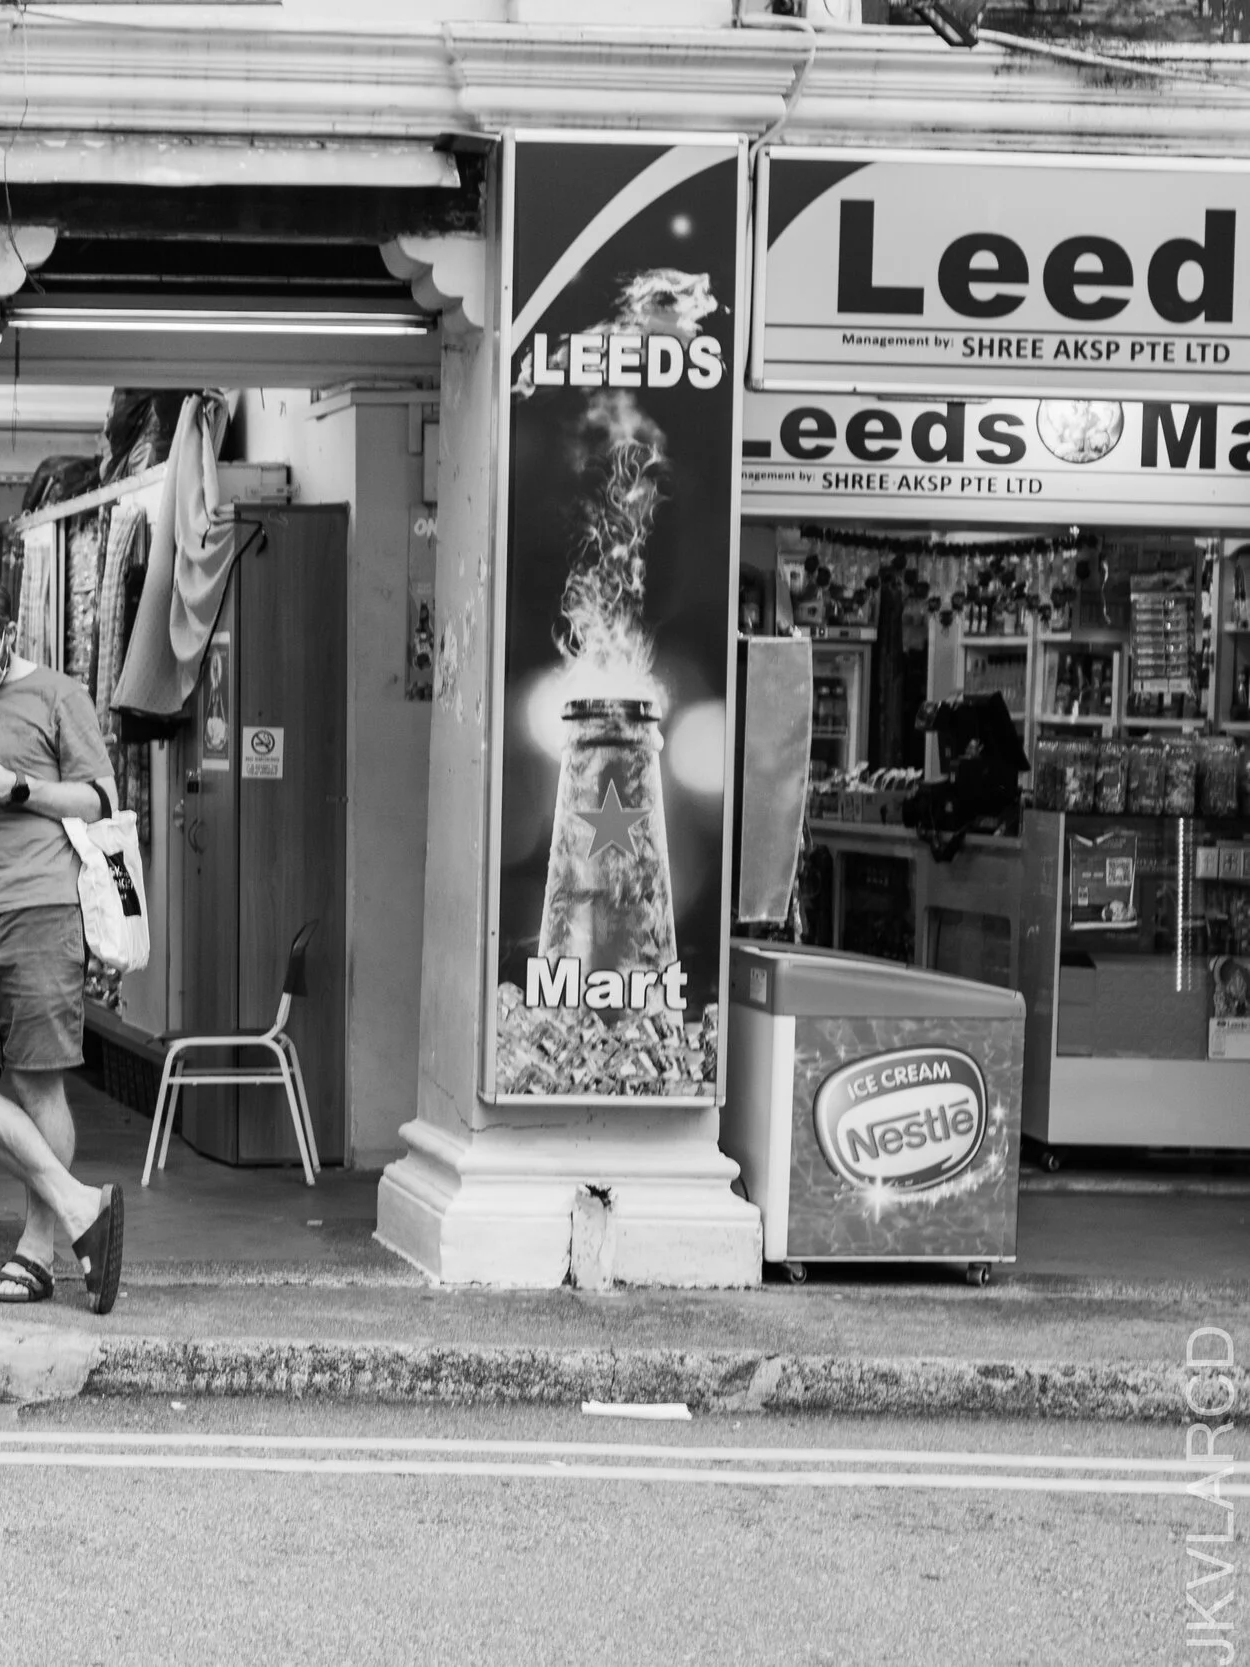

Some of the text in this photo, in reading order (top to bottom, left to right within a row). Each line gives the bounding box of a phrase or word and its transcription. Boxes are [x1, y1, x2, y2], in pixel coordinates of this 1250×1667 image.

[837, 198, 1237, 324] Leed
[533, 333, 724, 390] LEEDS
[841, 332, 930, 349] Management
[961, 335, 1045, 359] SHREE
[1053, 338, 1121, 361] AKSP
[1129, 340, 1176, 362] PTE
[1186, 341, 1231, 364] LTD
[741, 401, 1028, 465] eeds
[821, 471, 890, 491] SHREE
[897, 473, 952, 492] AKSP
[960, 475, 998, 494] PTE
[1005, 476, 1043, 495] LTD
[525, 956, 689, 1010] Mart
[847, 1060, 952, 1101] ICE CREAM
